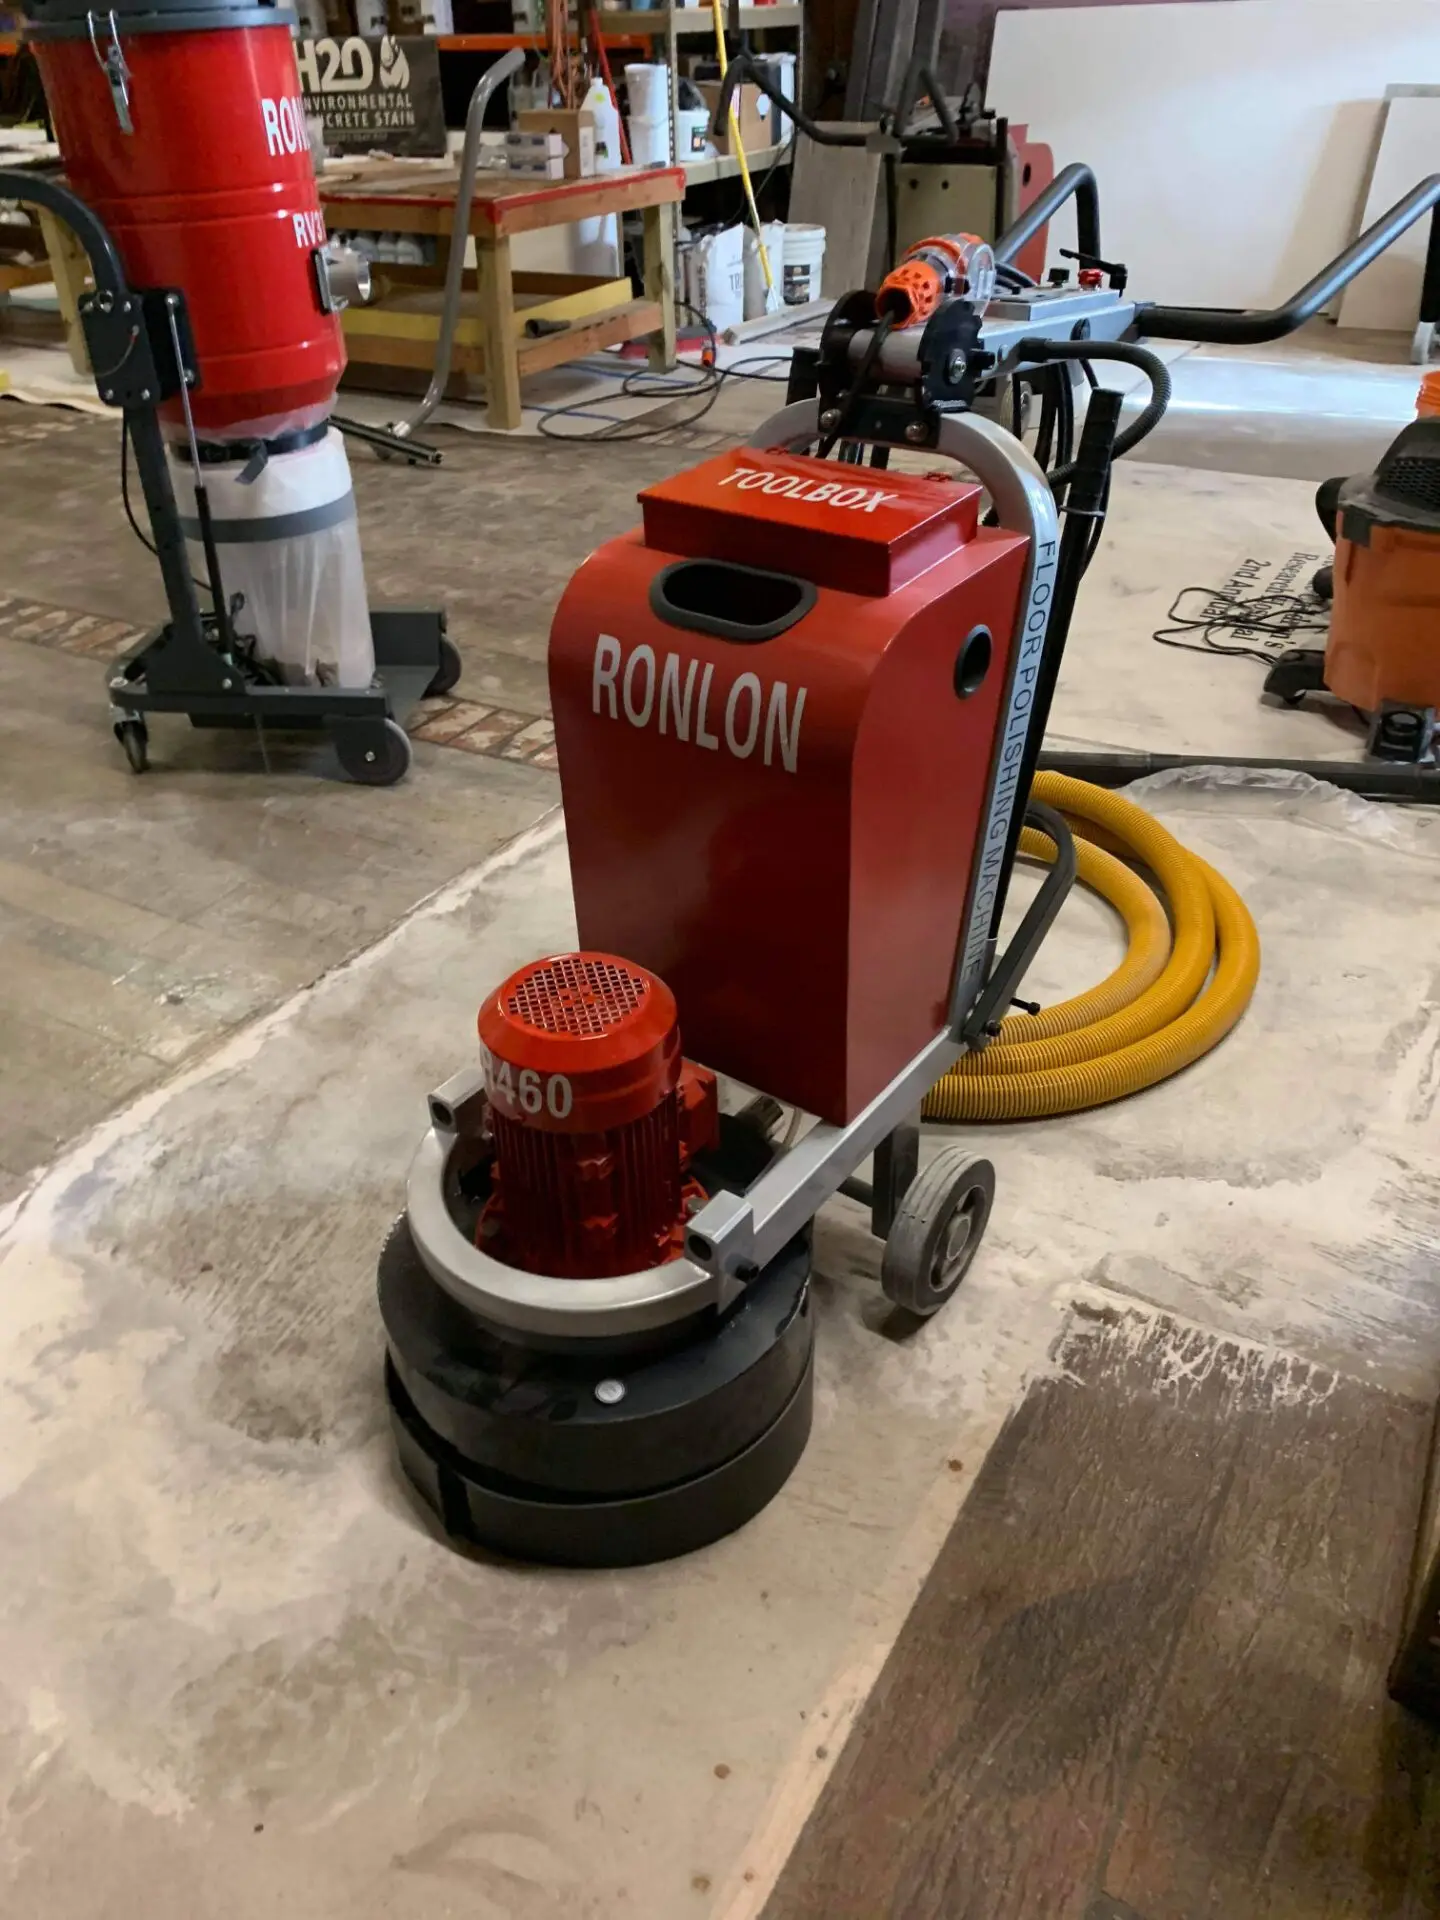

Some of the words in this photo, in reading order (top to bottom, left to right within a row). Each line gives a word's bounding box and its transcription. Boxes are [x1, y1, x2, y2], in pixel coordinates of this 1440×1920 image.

[303, 92, 412, 111] NVIRONMENTAL
[374, 108, 415, 126] STAIN
[718, 467, 900, 513] TOOLBOX
[1233, 558, 1272, 580] 2nd
[1265, 551, 1320, 593] Research
[1022, 540, 1056, 659] FLOOR
[1199, 579, 1255, 619] Annual
[593, 633, 808, 773] RONLON
[990, 668, 1037, 840] POLISHING
[961, 848, 1003, 983] MACHINE
